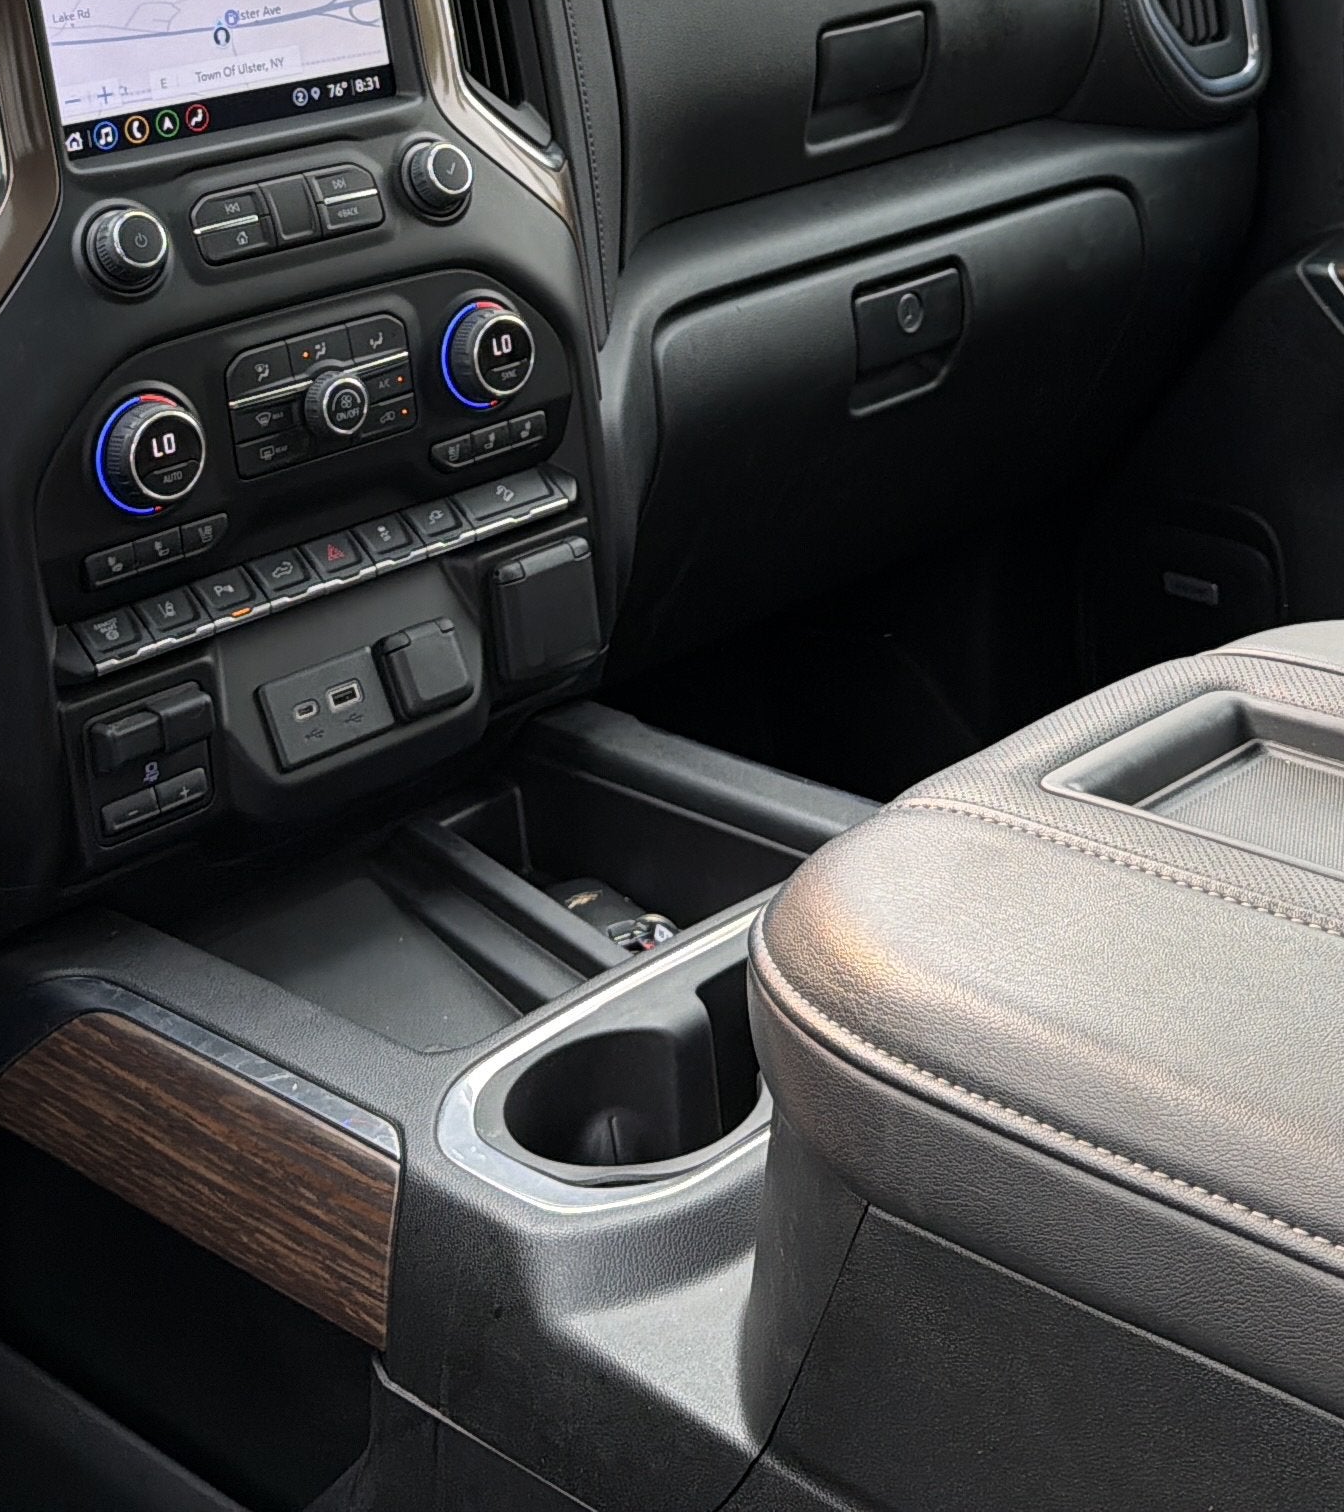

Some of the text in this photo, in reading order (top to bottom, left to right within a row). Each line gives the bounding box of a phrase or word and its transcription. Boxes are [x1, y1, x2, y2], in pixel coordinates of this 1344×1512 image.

[52, 8, 90, 23] Lake Rd
[263, 4, 282, 17] Ave
[195, 57, 284, 83] Town Of Ulster, NY
[356, 76, 380, 93] 8:31
[492, 334, 513, 356] LO
[336, 406, 360, 422] ON/OFF
[152, 432, 176, 458] LO
[163, 471, 183, 484] AUTO
